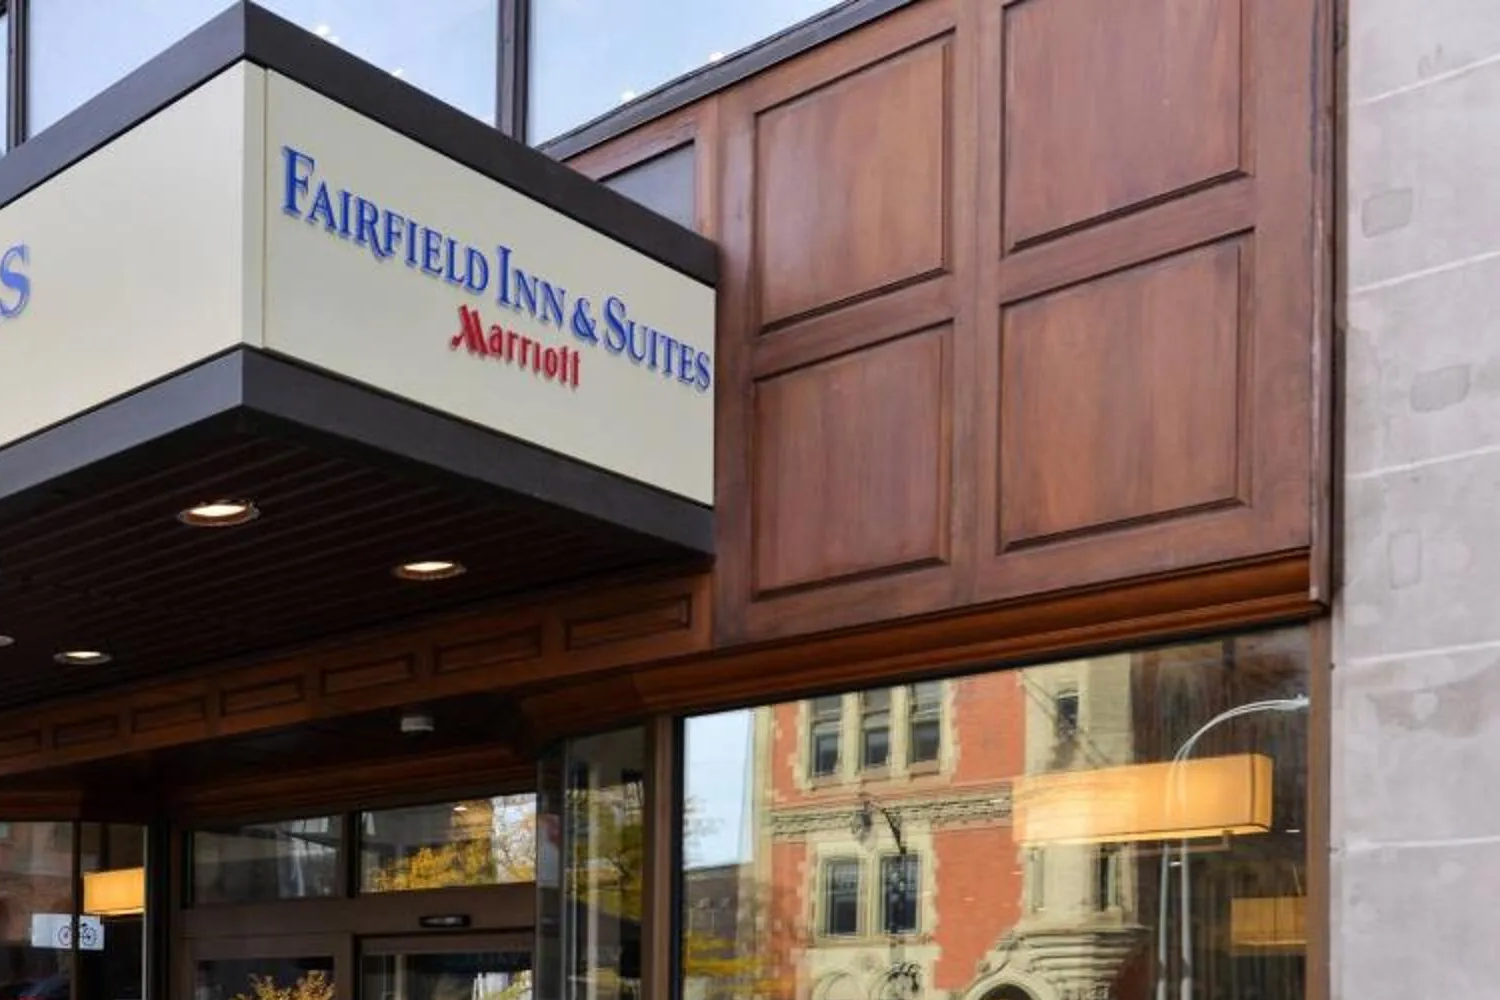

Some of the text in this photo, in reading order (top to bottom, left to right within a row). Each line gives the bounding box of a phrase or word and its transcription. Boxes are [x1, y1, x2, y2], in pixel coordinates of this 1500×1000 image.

[281, 145, 712, 392] FAIRFIELD INN & SUITES
[449, 303, 581, 389] Marriott
